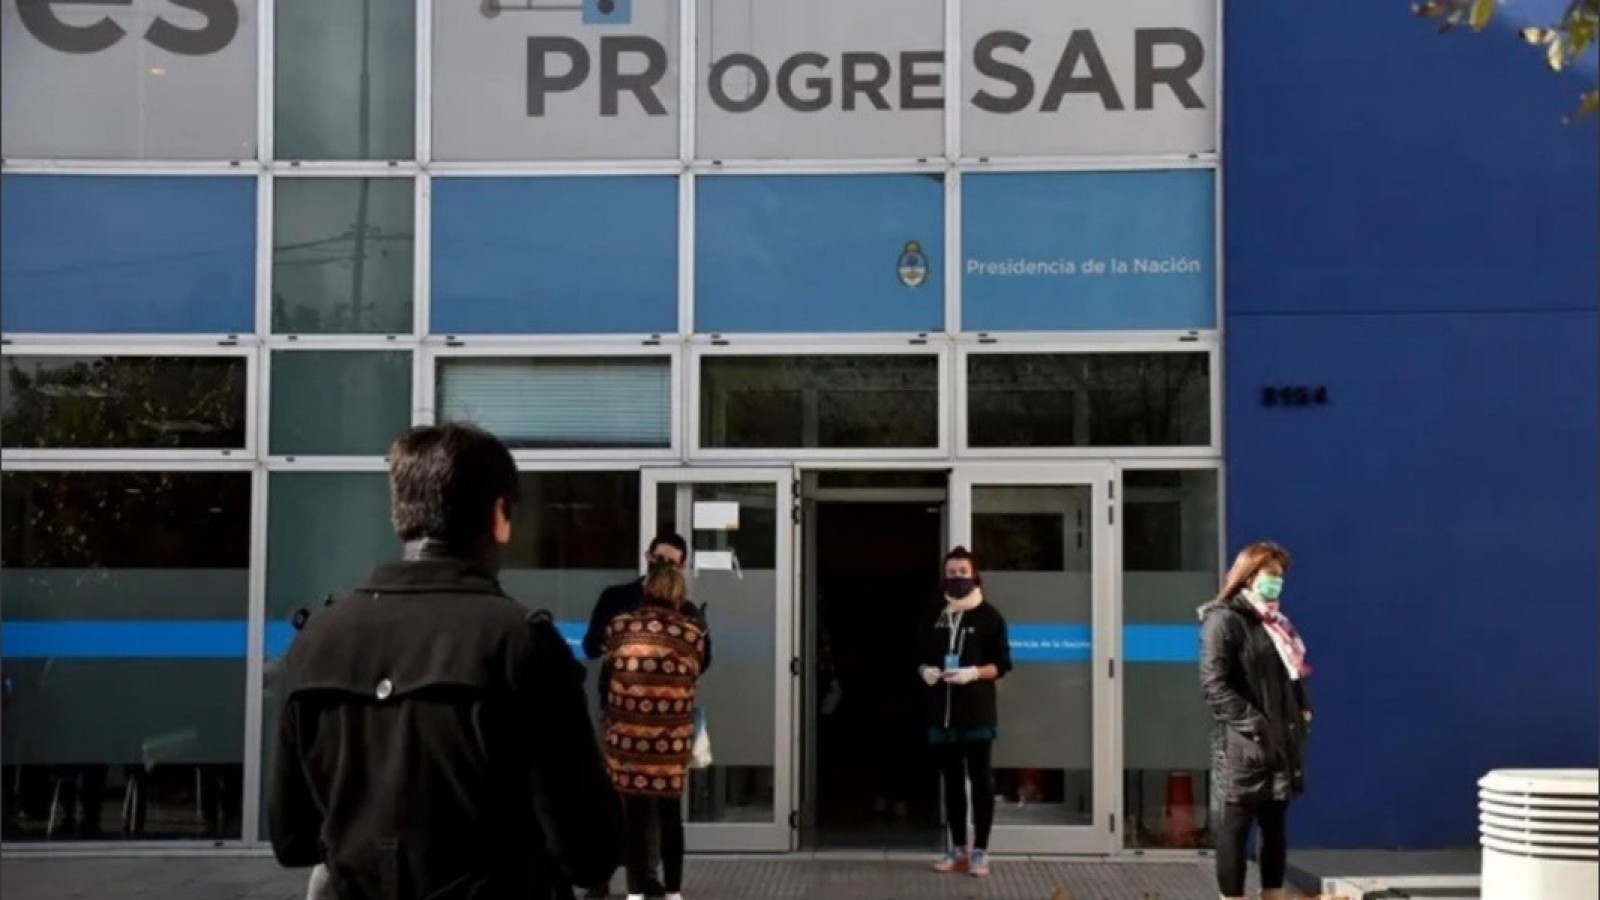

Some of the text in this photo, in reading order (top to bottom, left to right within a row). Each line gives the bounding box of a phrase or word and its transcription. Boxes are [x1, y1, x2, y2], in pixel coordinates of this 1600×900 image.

[966, 256, 1201, 275] Presidencia de la Nación
